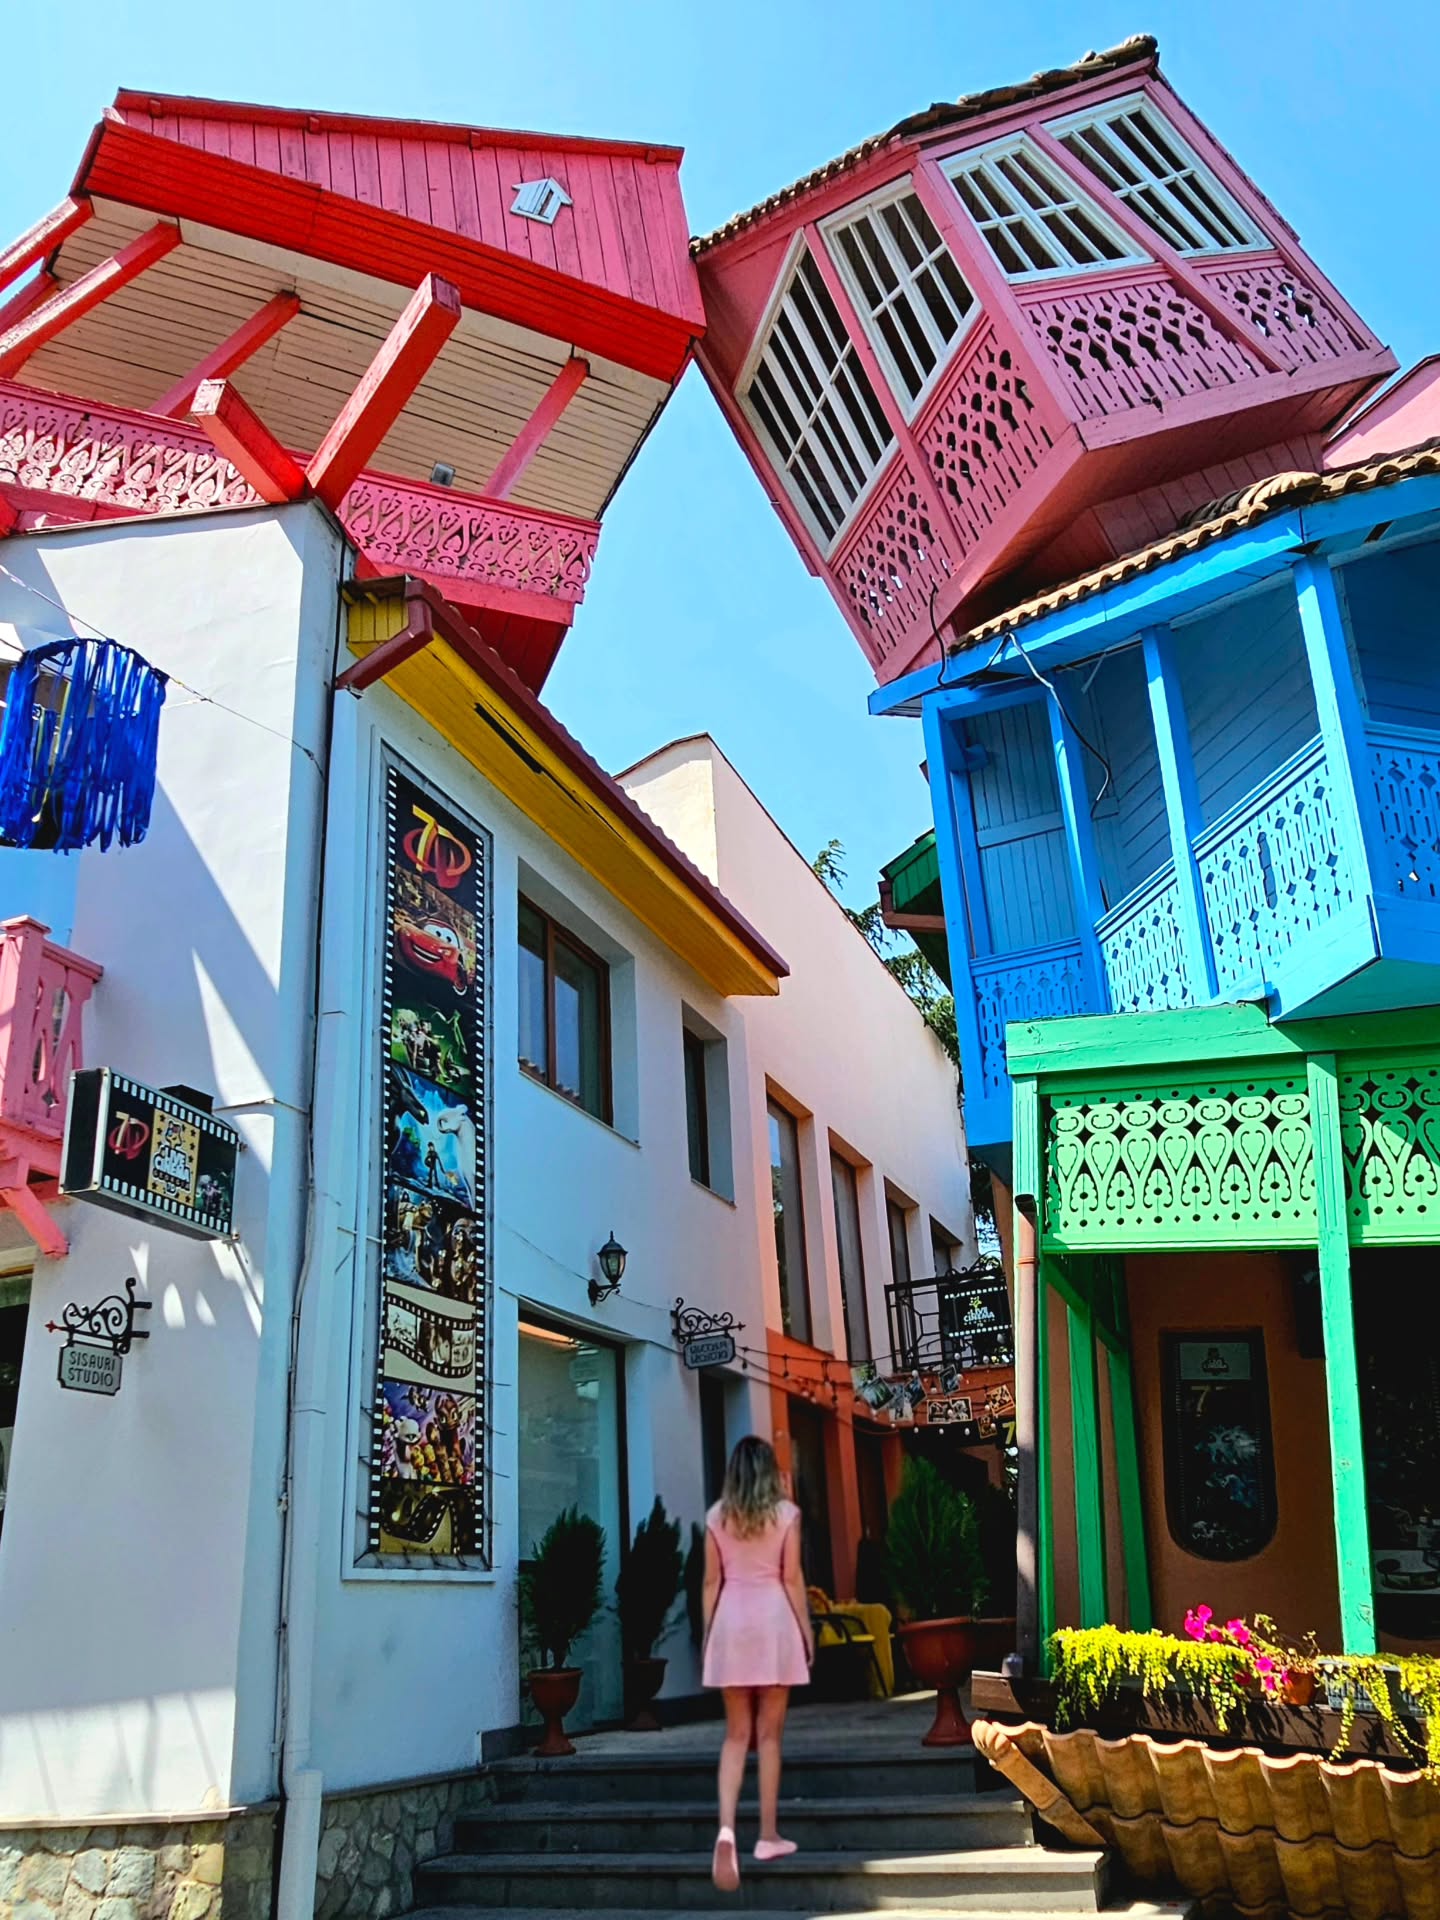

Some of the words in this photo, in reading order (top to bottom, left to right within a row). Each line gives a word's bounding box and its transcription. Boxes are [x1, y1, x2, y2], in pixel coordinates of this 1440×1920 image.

[164, 1146, 186, 1164] LIVE
[154, 1157, 191, 1182] CINEMA
[963, 1311, 995, 1322] CINEMA
[70, 1351, 115, 1371] SISAURI
[68, 1367, 113, 1387] STUDIO
